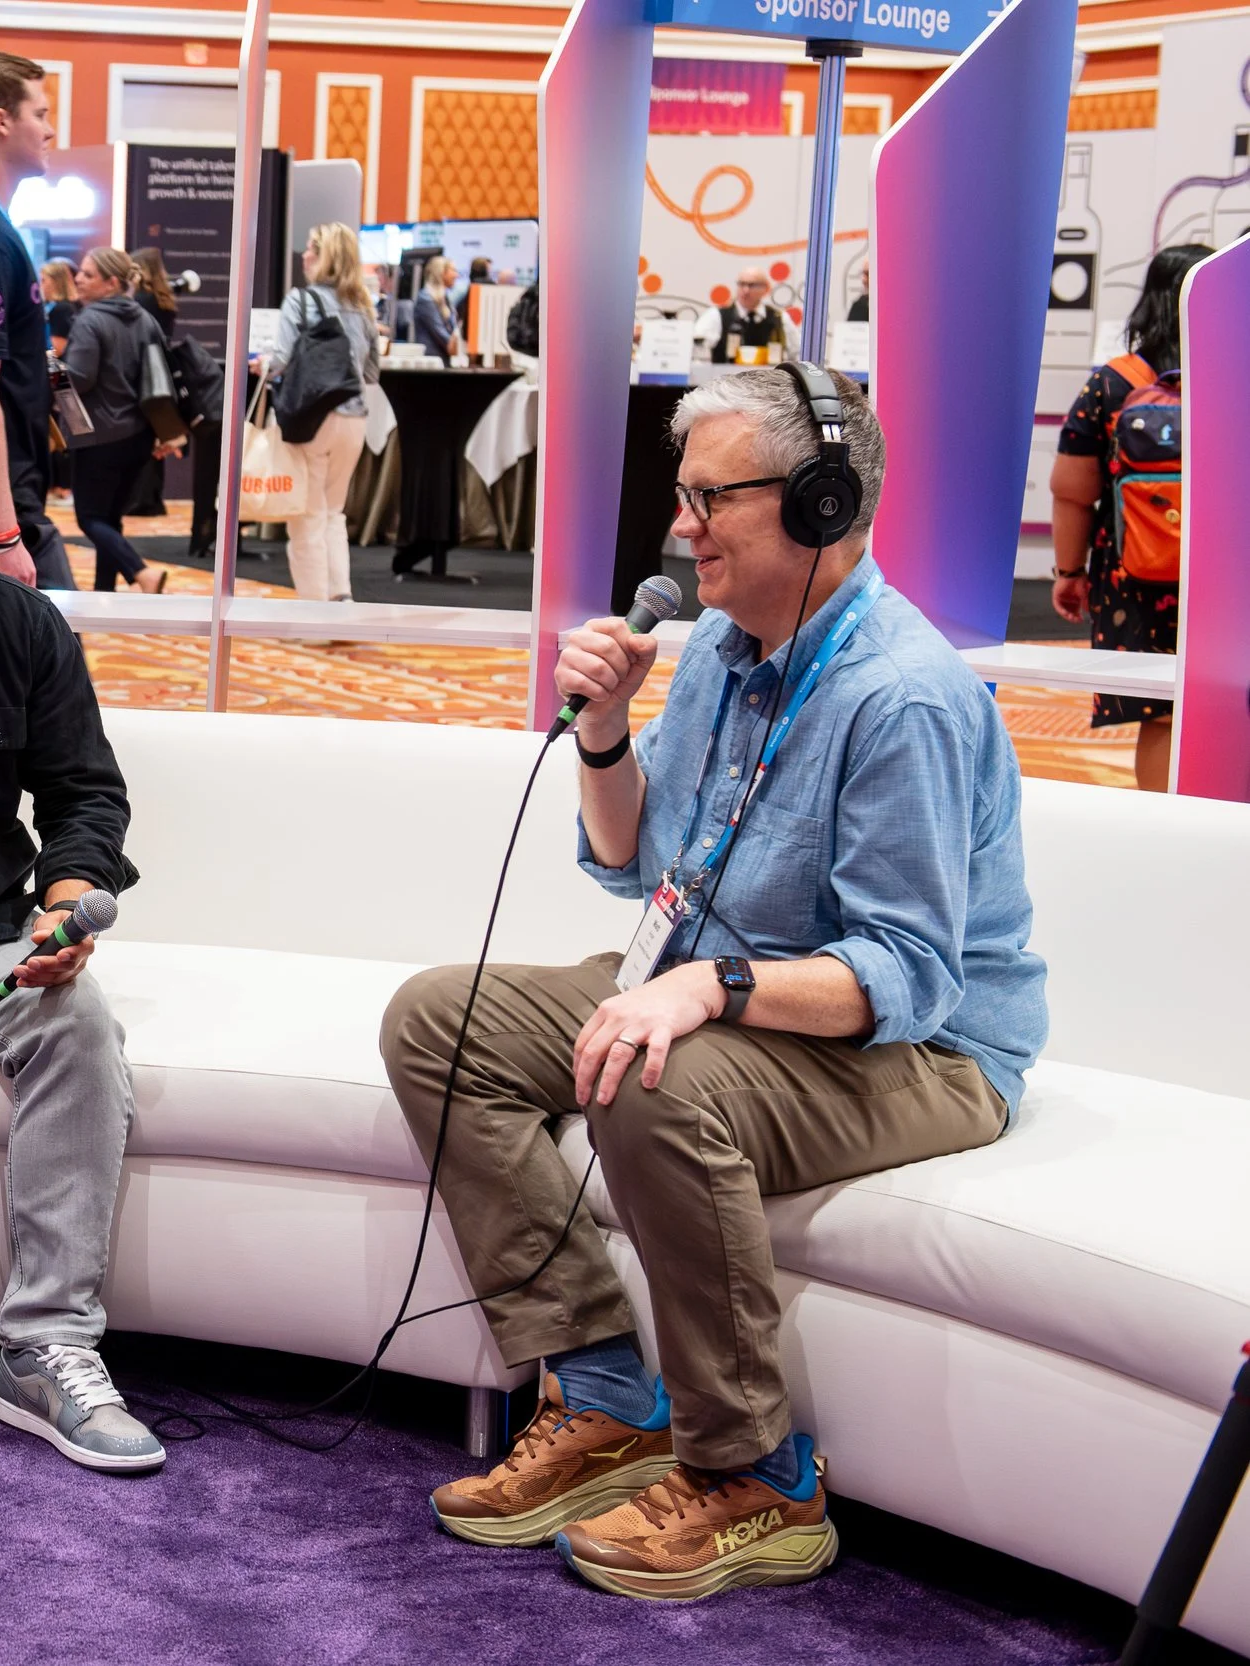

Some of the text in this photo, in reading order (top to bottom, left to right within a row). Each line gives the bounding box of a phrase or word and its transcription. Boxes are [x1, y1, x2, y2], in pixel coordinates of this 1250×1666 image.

[863, 1, 950, 39] Lounge
[700, 86, 749, 107] Lounge
[713, 1507, 784, 1557] HOKA
